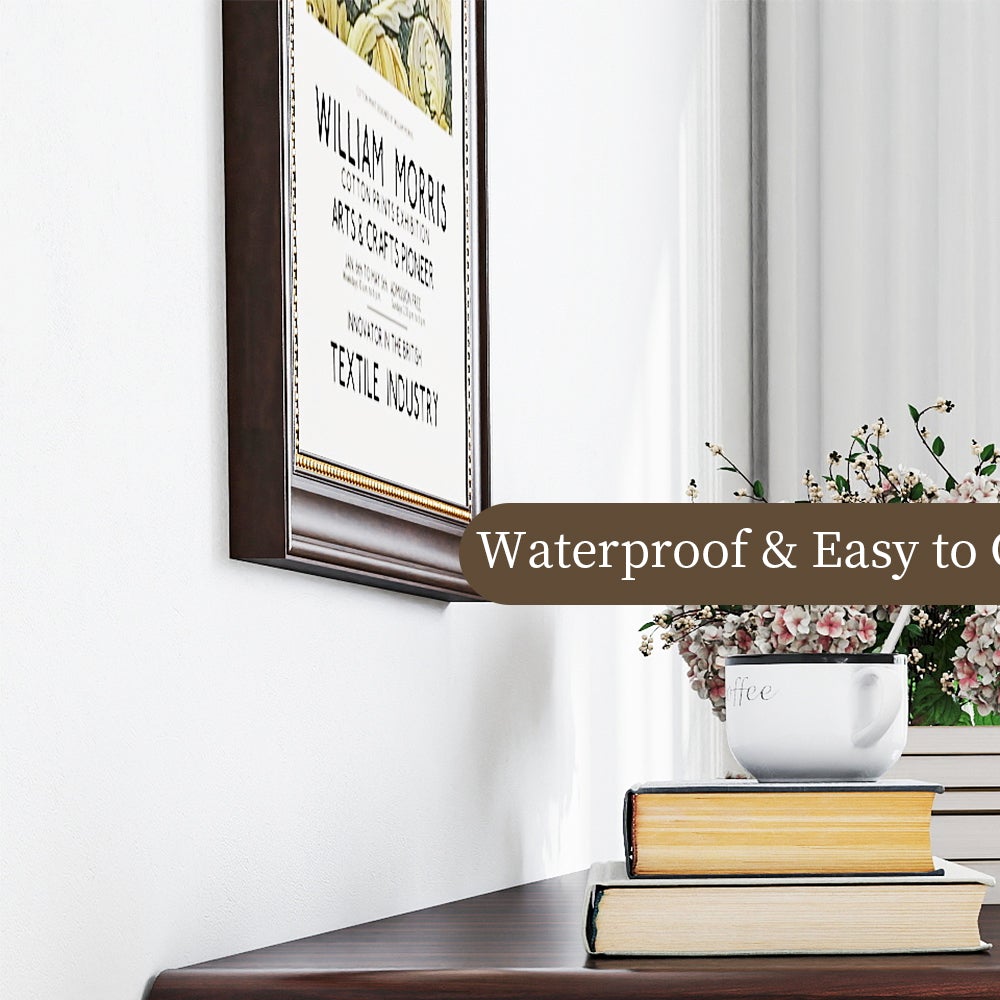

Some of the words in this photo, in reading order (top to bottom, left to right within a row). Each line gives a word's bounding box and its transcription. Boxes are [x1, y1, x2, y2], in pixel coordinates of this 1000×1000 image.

[315, 84, 384, 187] WILLIAM
[395, 147, 447, 232] MORRIS
[341, 166, 372, 204] COTTON
[372, 187, 395, 222] PRINTS
[331, 196, 356, 242] ARTS
[357, 212, 364, 246] &
[366, 218, 400, 269] CRAFTS
[401, 240, 435, 290] PIONEER
[348, 310, 382, 347] INNOVATOR
[330, 340, 380, 402] TEXTILE
[386, 367, 439, 428] INDUSTRY
[727, 675, 780, 707] ffee
